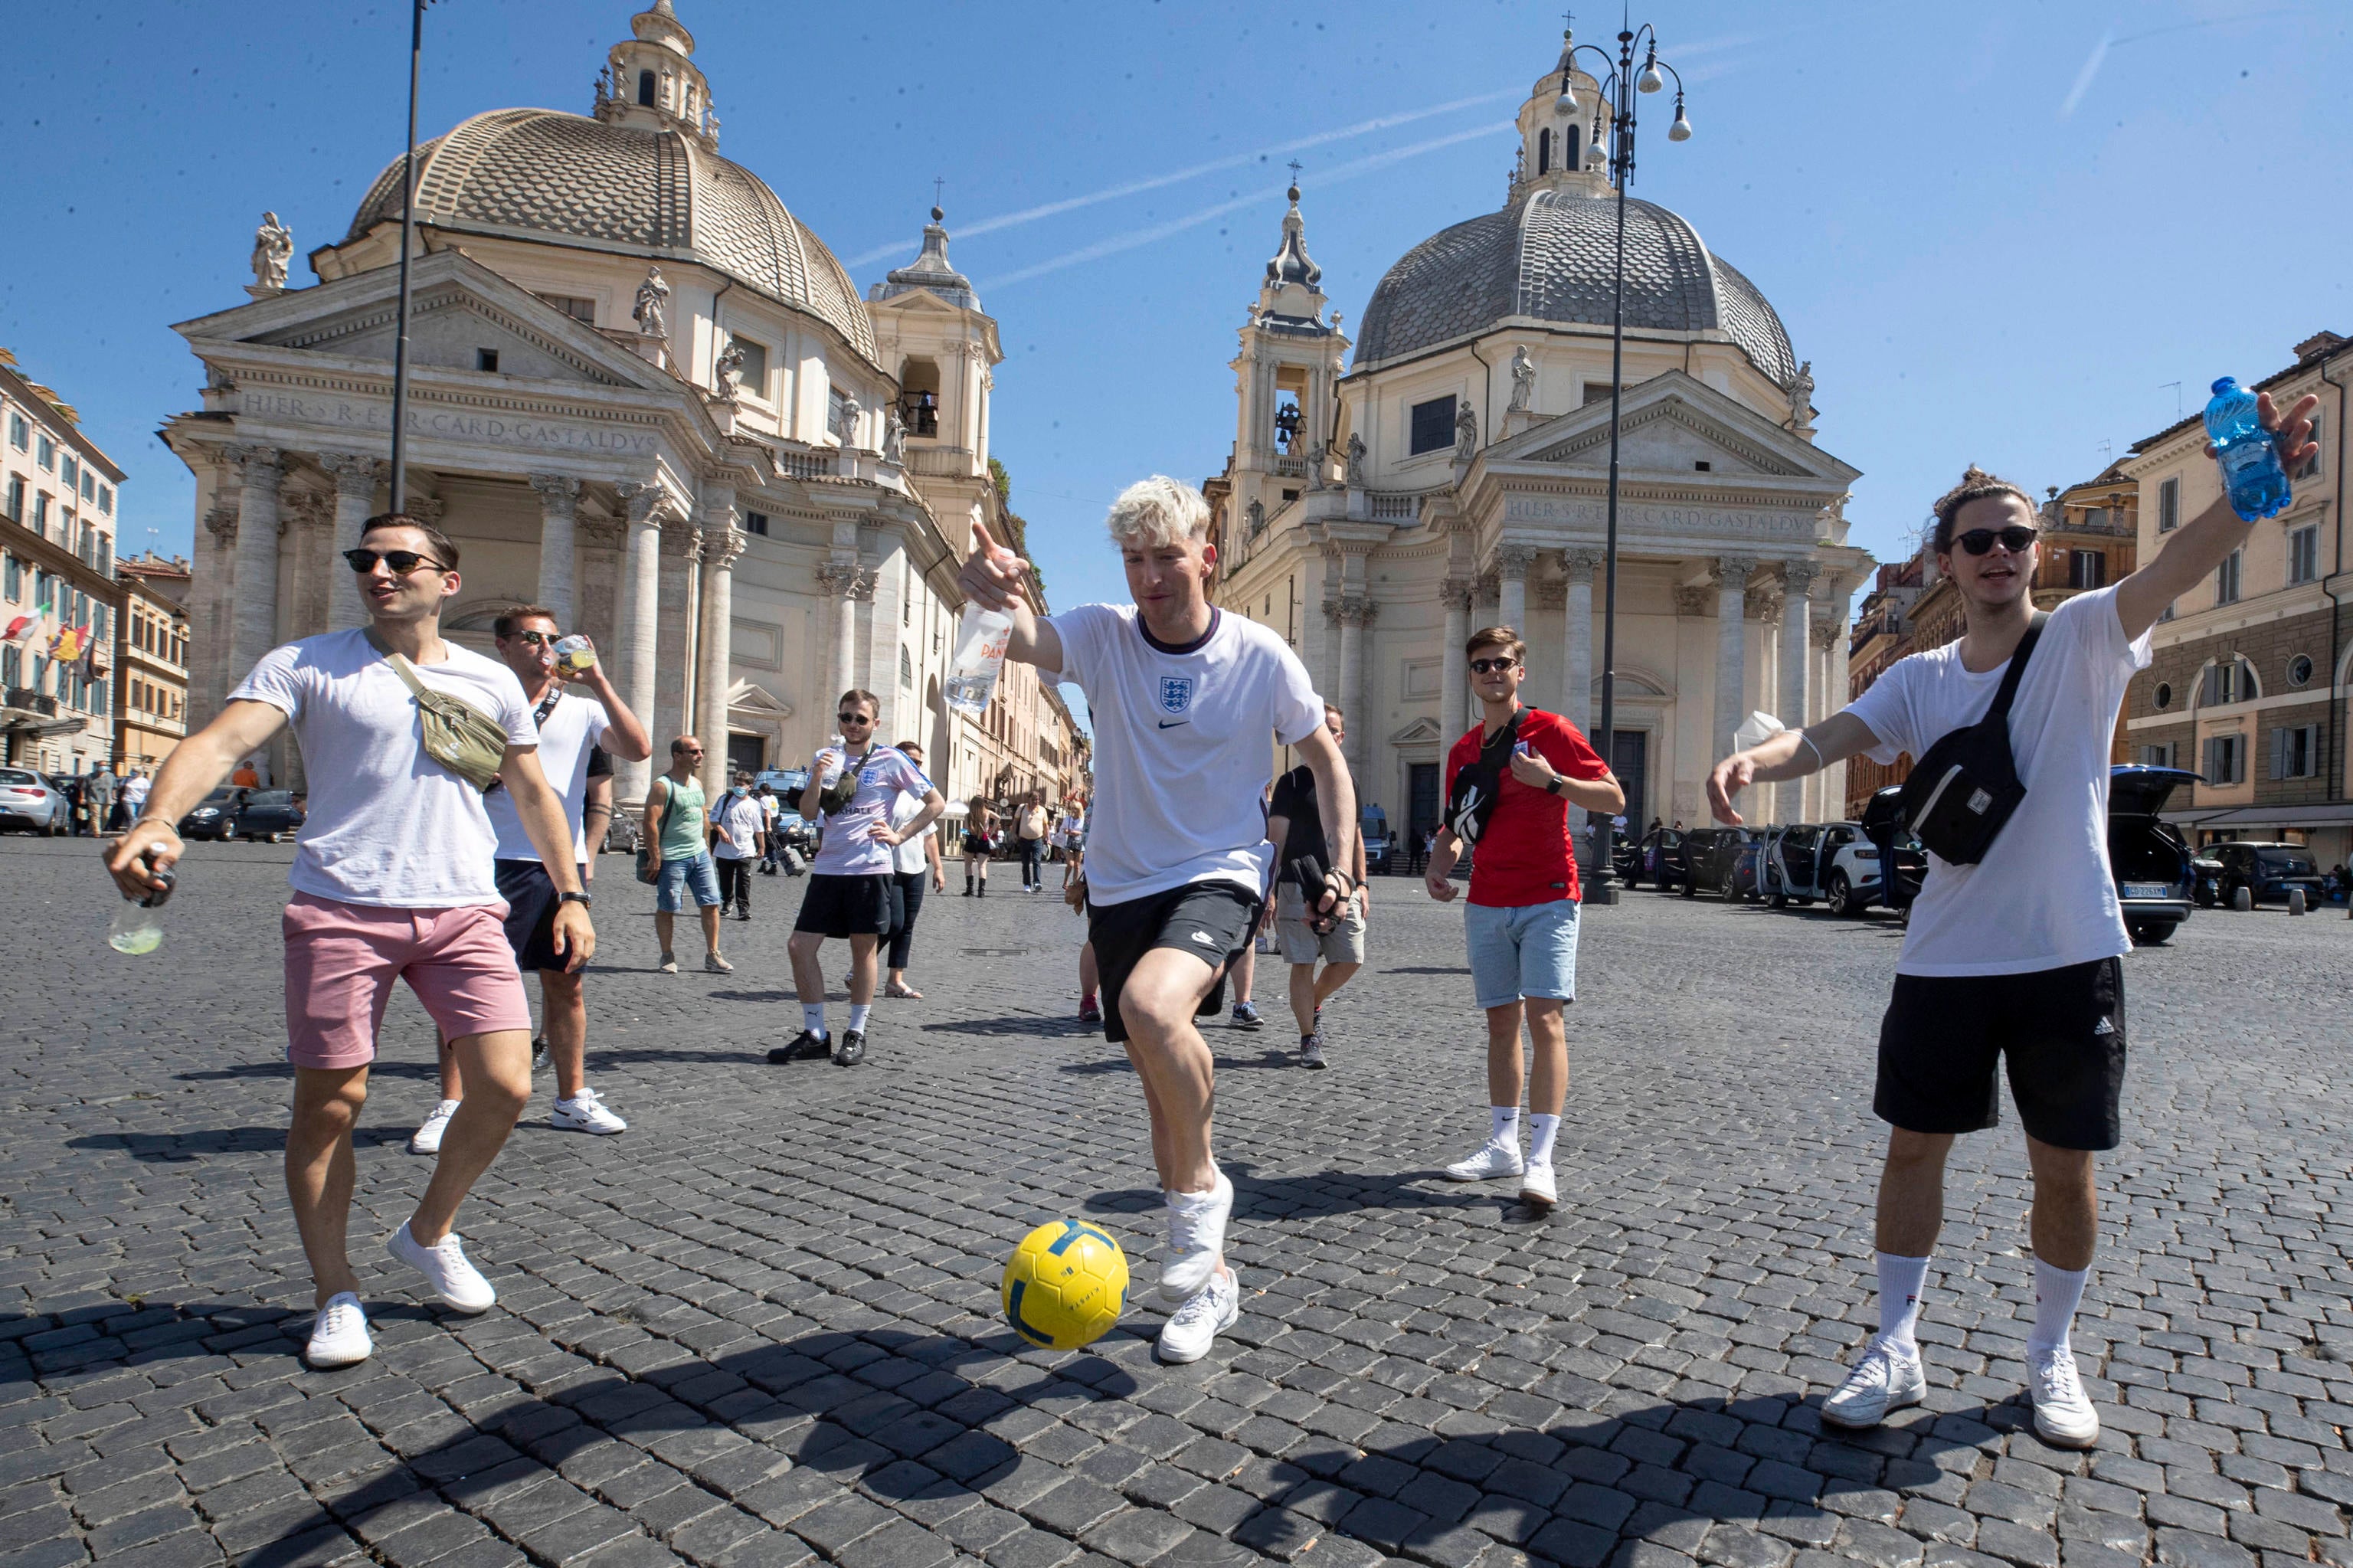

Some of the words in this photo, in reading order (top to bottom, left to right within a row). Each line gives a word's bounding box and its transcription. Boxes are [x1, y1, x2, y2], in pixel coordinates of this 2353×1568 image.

[244, 394, 306, 416] HIER
[431, 414, 505, 437] CARD
[515, 423, 657, 450] GASTALDVS
[1510, 501, 1555, 517] HIER
[1644, 508, 1700, 526] CARD
[1708, 512, 1815, 531] GASTALDVS
